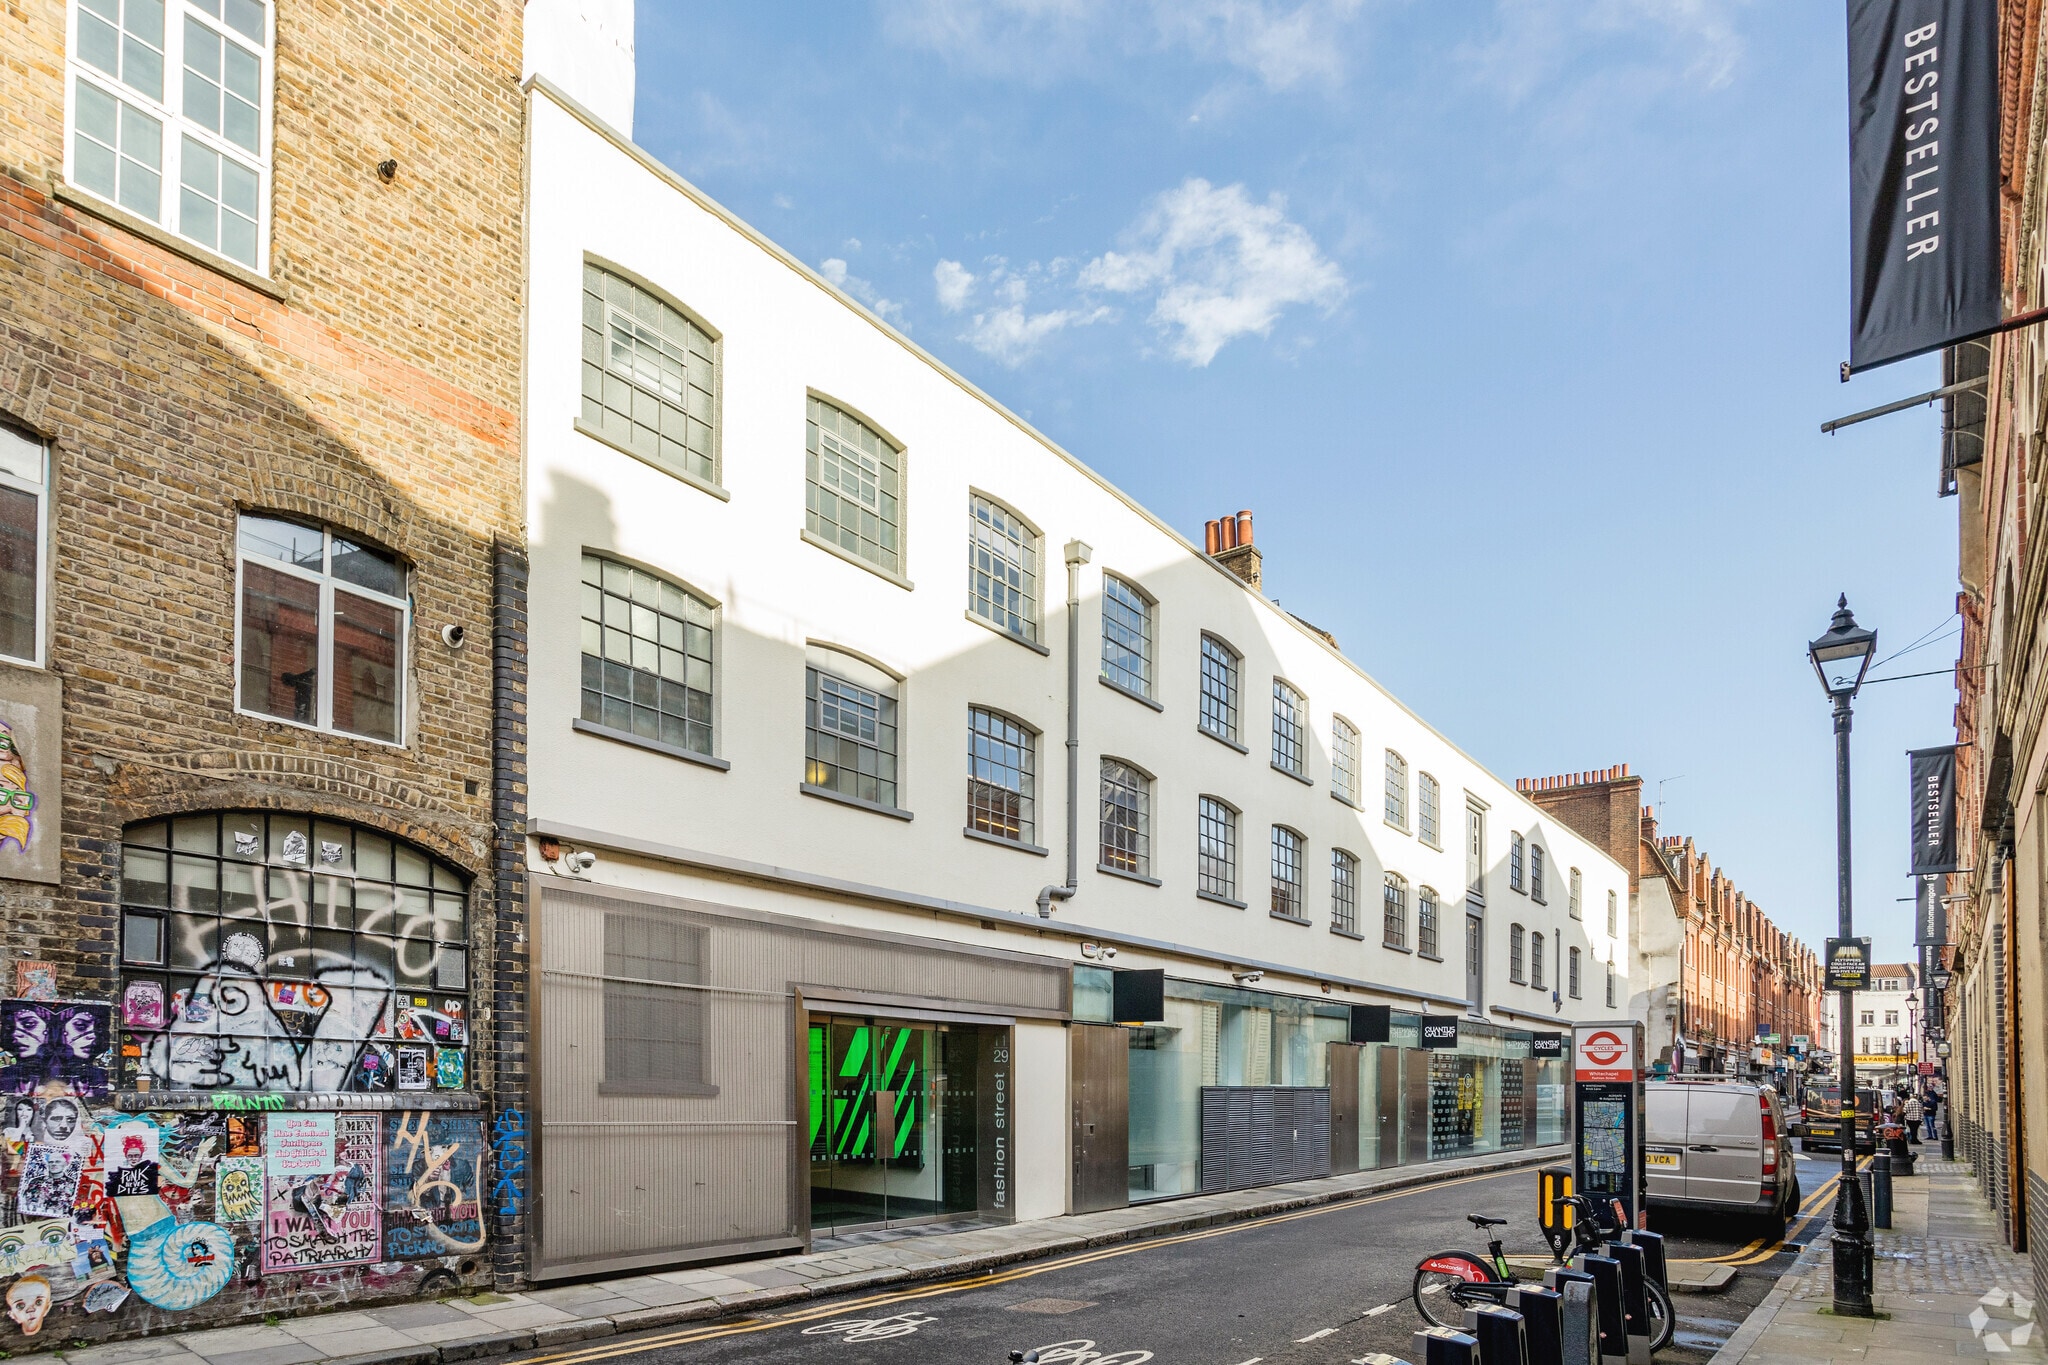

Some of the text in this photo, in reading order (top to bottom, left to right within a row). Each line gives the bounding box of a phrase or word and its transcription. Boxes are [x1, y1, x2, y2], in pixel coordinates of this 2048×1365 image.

[1903, 21, 1940, 262] BESTSELLER
[1927, 775, 1940, 847] BESTSELLER
[993, 1049, 1009, 1063] 29
[287, 1120, 317, 1129] You Can
[345, 1120, 373, 1131] MEN
[281, 1139, 323, 1148] Intelligence
[994, 1072, 1005, 1209] fashion street
[345, 1149, 373, 1160] MEN
[1653, 1155, 1671, 1164] VCA
[282, 1159, 321, 1168] Psychopath
[120, 1165, 150, 1184] PUNK
[117, 1184, 150, 1194] DIES
[450, 1203, 478, 1219] YOU
[274, 1218, 279, 1234] I
[341, 1211, 371, 1229] YOU
[264, 1236, 289, 1250] TO
[349, 1229, 379, 1242] THE
[387, 1227, 412, 1242] TO
[269, 1244, 374, 1266] PATRIARCHY
[388, 1240, 446, 1258] FUCKING
[1437, 1262, 1464, 1271] Santander
